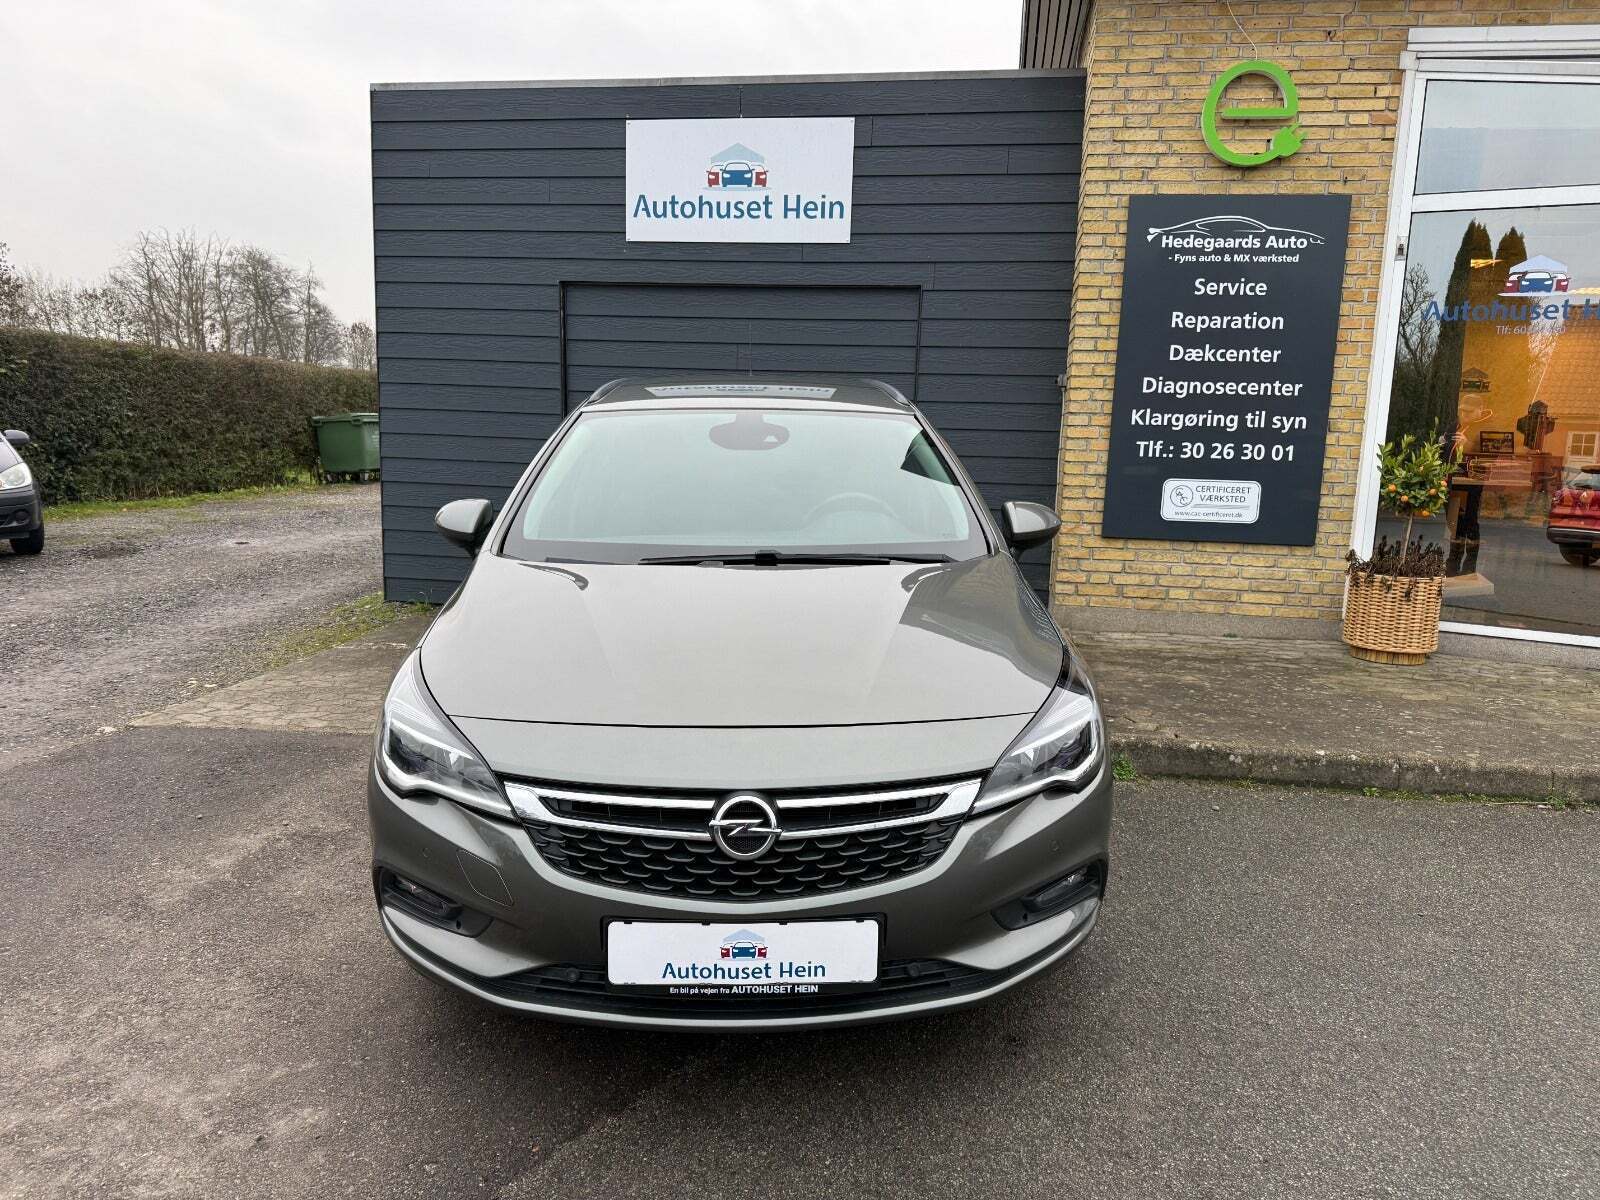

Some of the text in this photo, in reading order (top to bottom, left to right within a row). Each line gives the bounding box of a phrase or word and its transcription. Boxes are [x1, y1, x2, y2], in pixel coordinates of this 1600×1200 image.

[633, 194, 845, 219] Autohuset Hein
[1161, 235, 1308, 251] Hedegaards Auto
[1174, 254, 1196, 263] Fyns
[1198, 254, 1221, 262] auto
[1223, 254, 1231, 262] &
[1233, 254, 1250, 262] MX
[1252, 254, 1299, 263] værksted
[1194, 278, 1267, 296] Service
[1423, 298, 1570, 321] Autohuset
[1171, 311, 1284, 332] Reparation
[1169, 344, 1281, 363] Dækcenter
[1142, 376, 1303, 399] Diagnosecenter
[1131, 409, 1307, 433] Klargøring til syn
[1136, 441, 1295, 461] Tlf.: 30 26 30 01
[1195, 485, 1252, 495] CERTIFICERET
[1199, 494, 1247, 504] VÆRKSTED
[661, 961, 826, 980] Autohuset Hein
[690, 986, 699, 996] på
[700, 986, 719, 996] vejen
[731, 985, 792, 994] AUTOHUSET
[794, 984, 819, 993] HEIN
